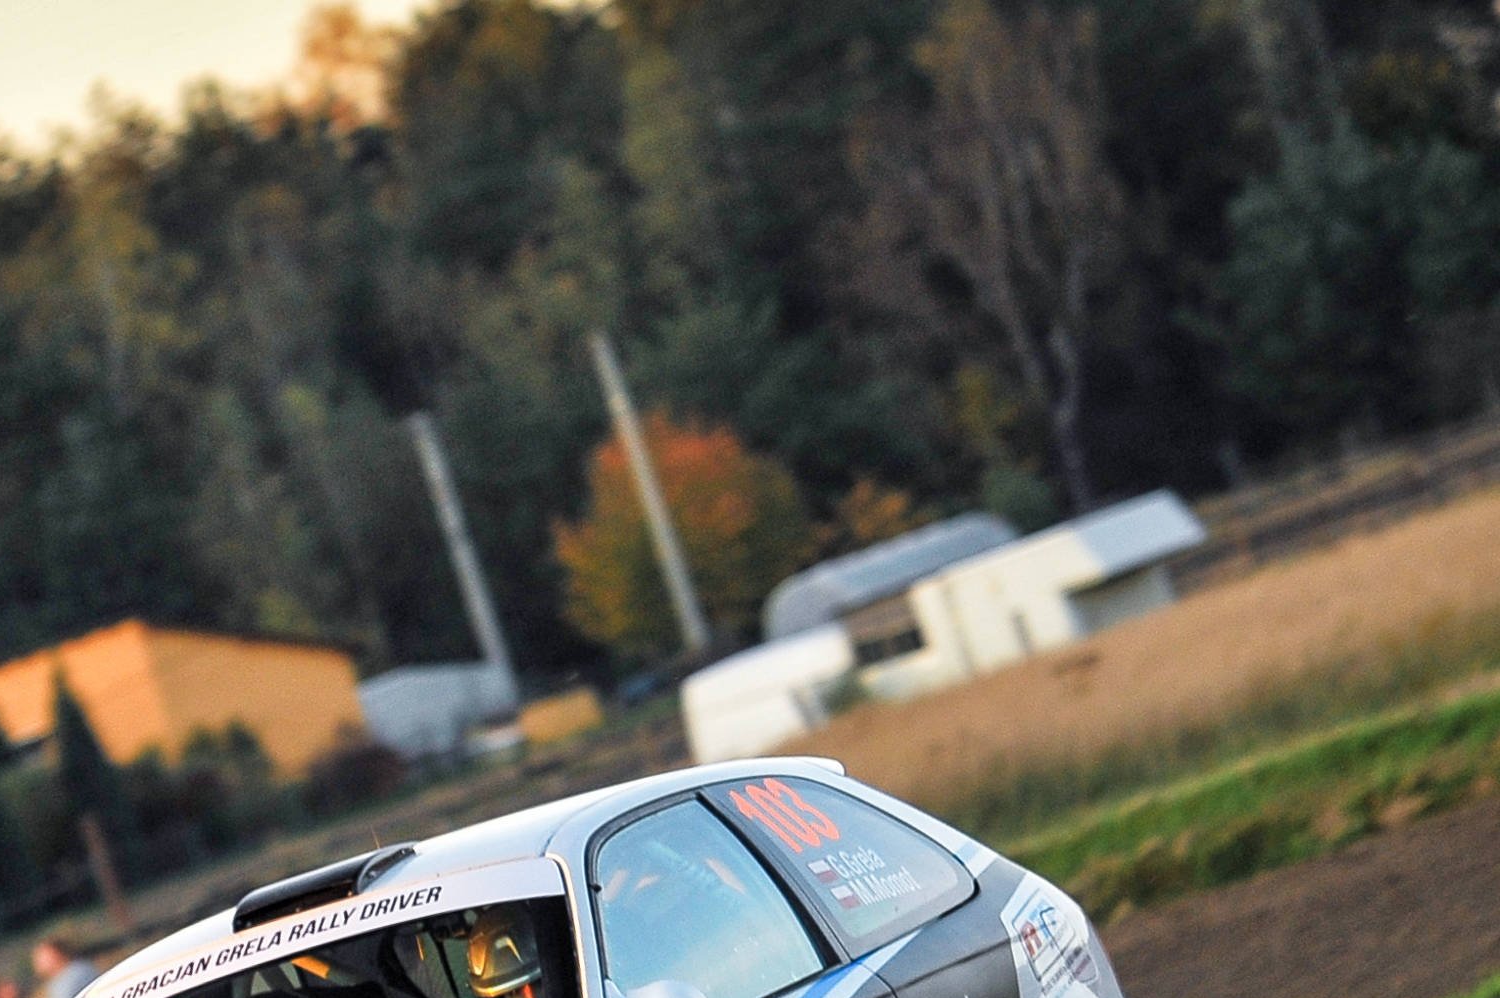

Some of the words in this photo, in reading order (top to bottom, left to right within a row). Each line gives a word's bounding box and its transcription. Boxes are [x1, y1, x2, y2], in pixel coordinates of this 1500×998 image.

[729, 778, 840, 853] 103
[216, 935, 282, 967] GRELA
[288, 908, 357, 943] RALLY
[360, 886, 443, 921] DRIVER
